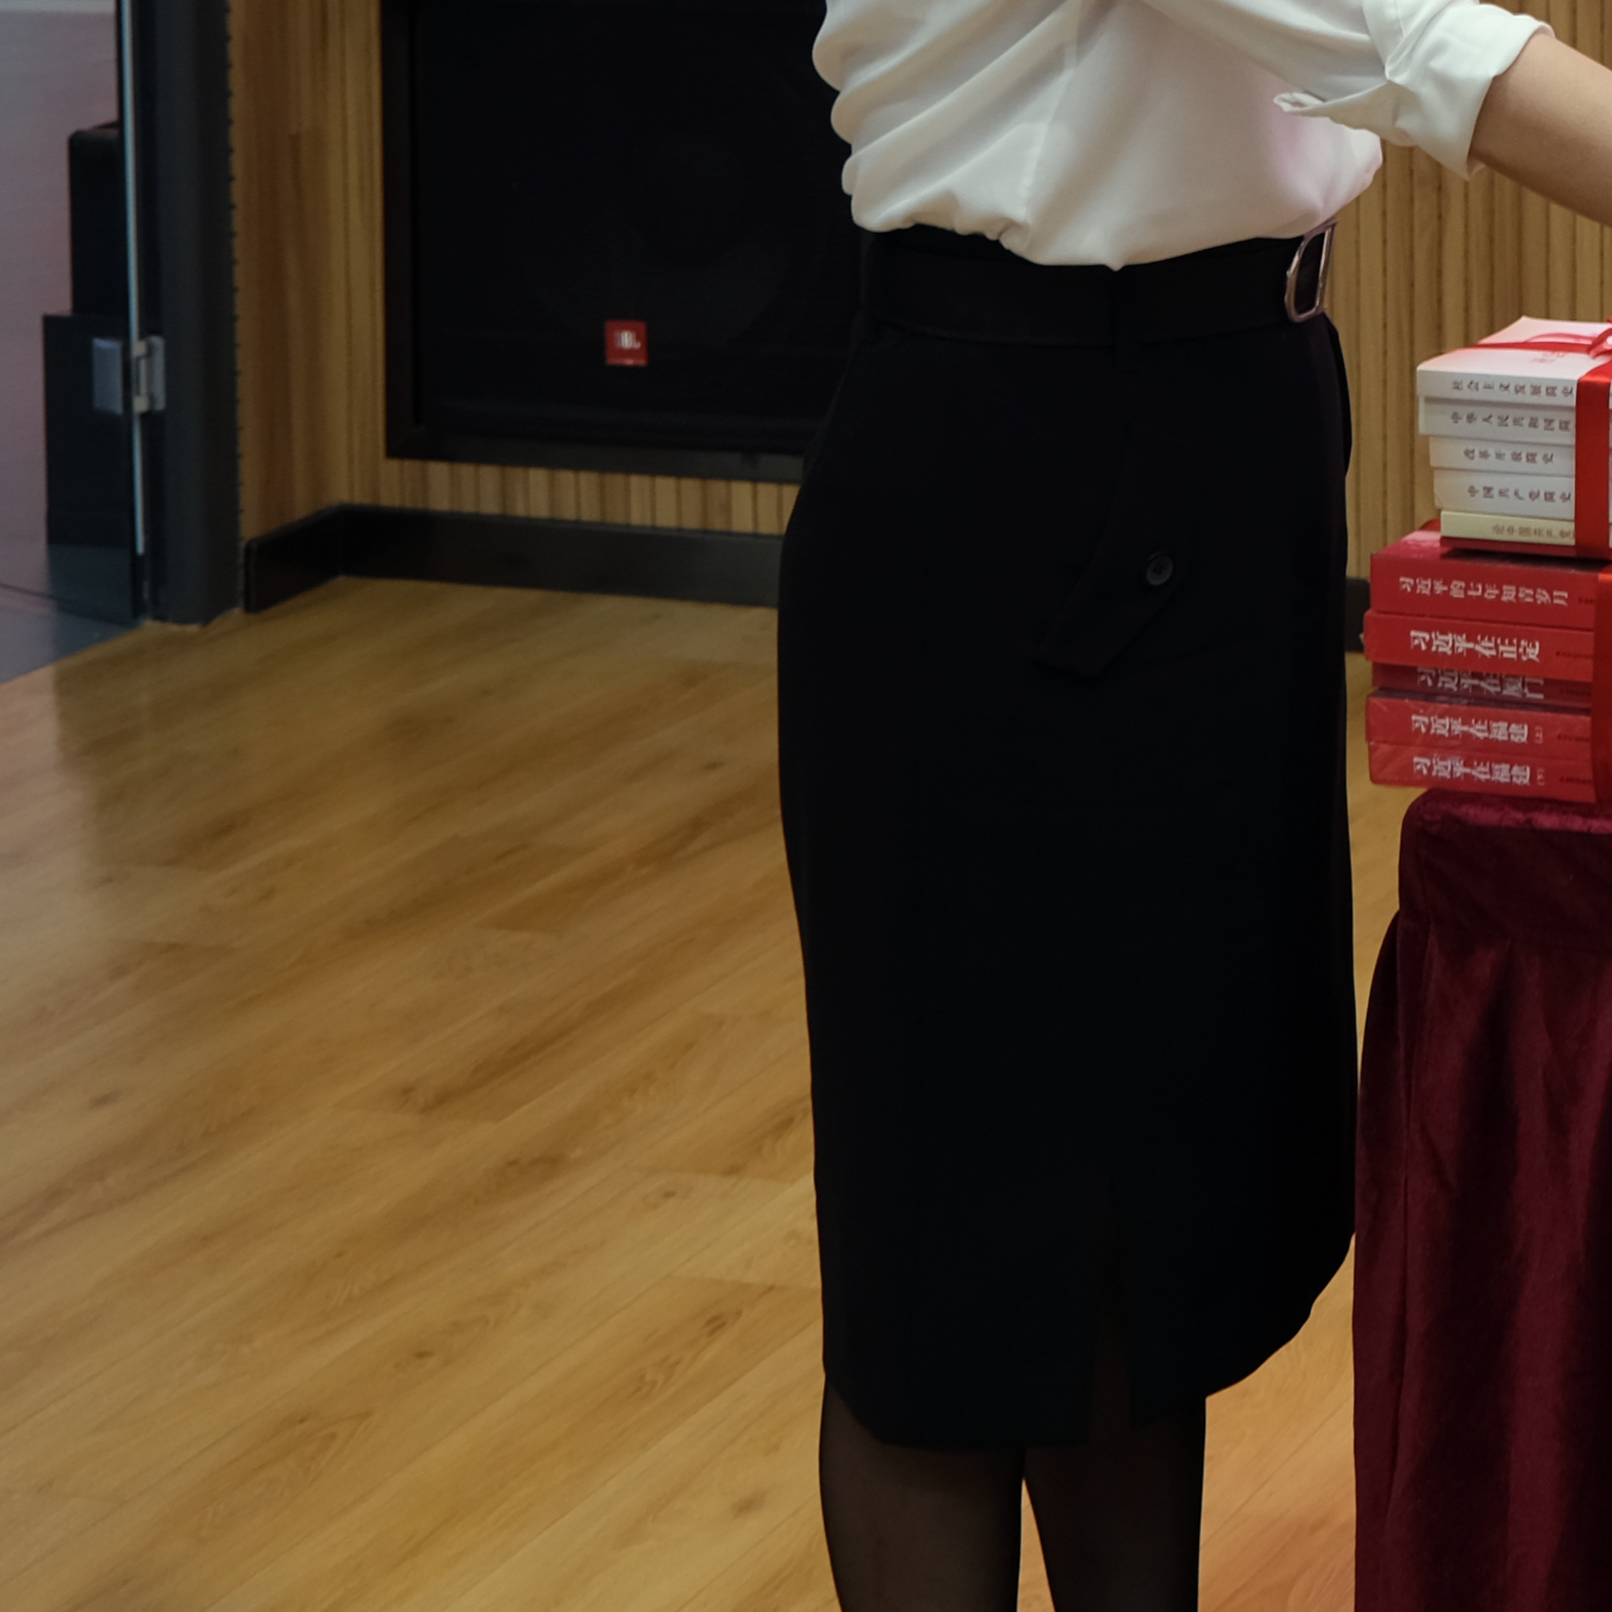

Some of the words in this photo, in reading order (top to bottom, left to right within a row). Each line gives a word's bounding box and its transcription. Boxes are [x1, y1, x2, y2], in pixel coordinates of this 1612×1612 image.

[1451, 378, 1574, 397] 社会主义发展简史
[1450, 410, 1572, 433] 中华人民共和国简
[1463, 447, 1555, 465] 改革开放简史
[1467, 484, 1572, 505] 中国共产党简史
[1399, 576, 1569, 607] 习近平的七年知青岁月
[1410, 630, 1541, 663] 习近平在正定
[1417, 667, 1545, 700] 习近平在厦门
[1411, 714, 1529, 744] 习近平在福建
[1412, 755, 1531, 786] 习近平在福建
